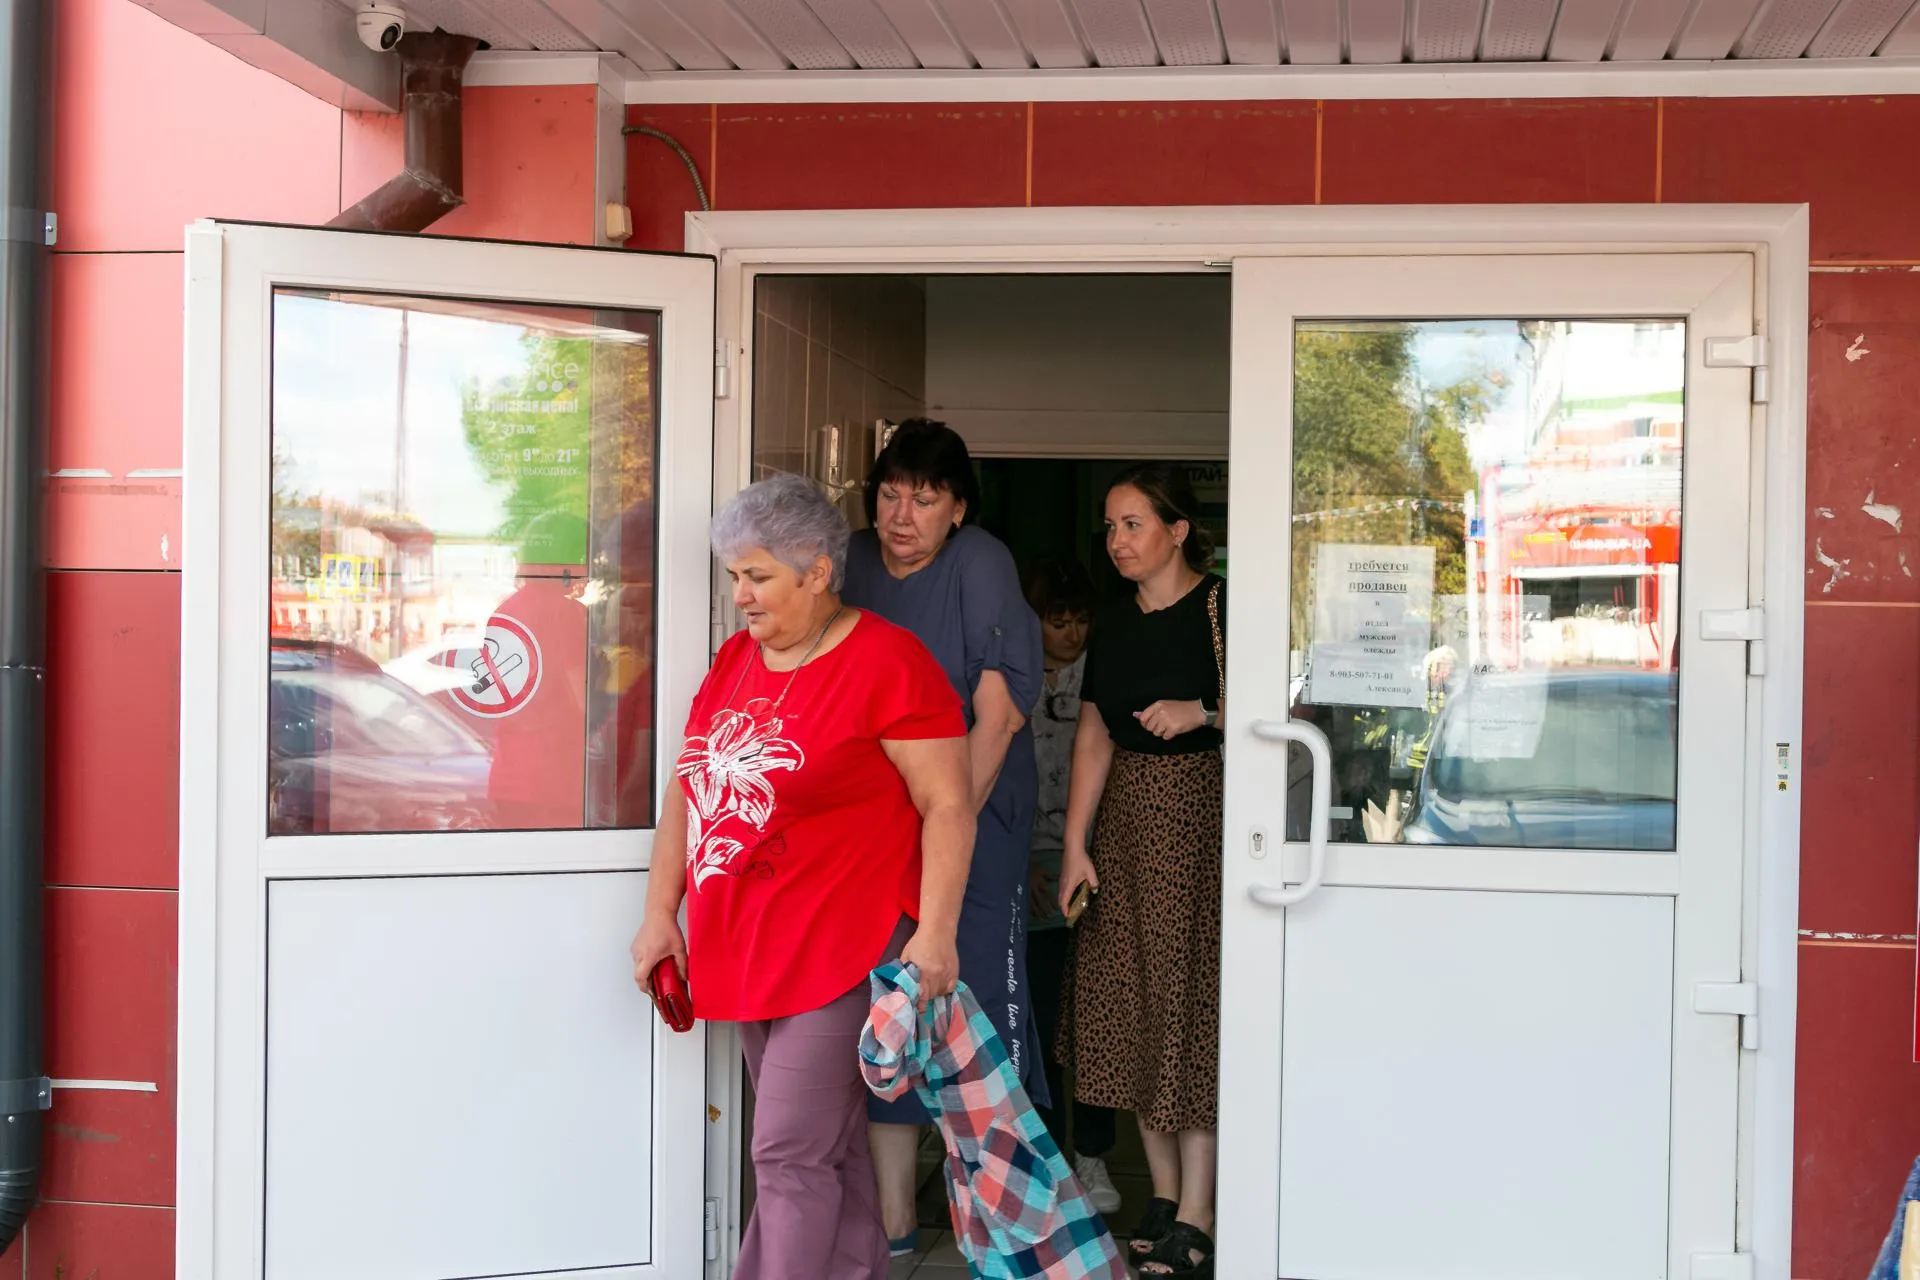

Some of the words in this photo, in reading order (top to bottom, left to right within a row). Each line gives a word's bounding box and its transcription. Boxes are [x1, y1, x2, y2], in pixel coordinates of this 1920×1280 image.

[488, 421, 497, 434] 2
[501, 423, 537, 436] этаж
[1348, 560, 1409, 573] требуется
[1360, 633, 1397, 642] мужской
[1365, 684, 1412, 696] Александр
[1007, 1003, 1019, 1030] live
[1011, 1038, 1021, 1078] happ
